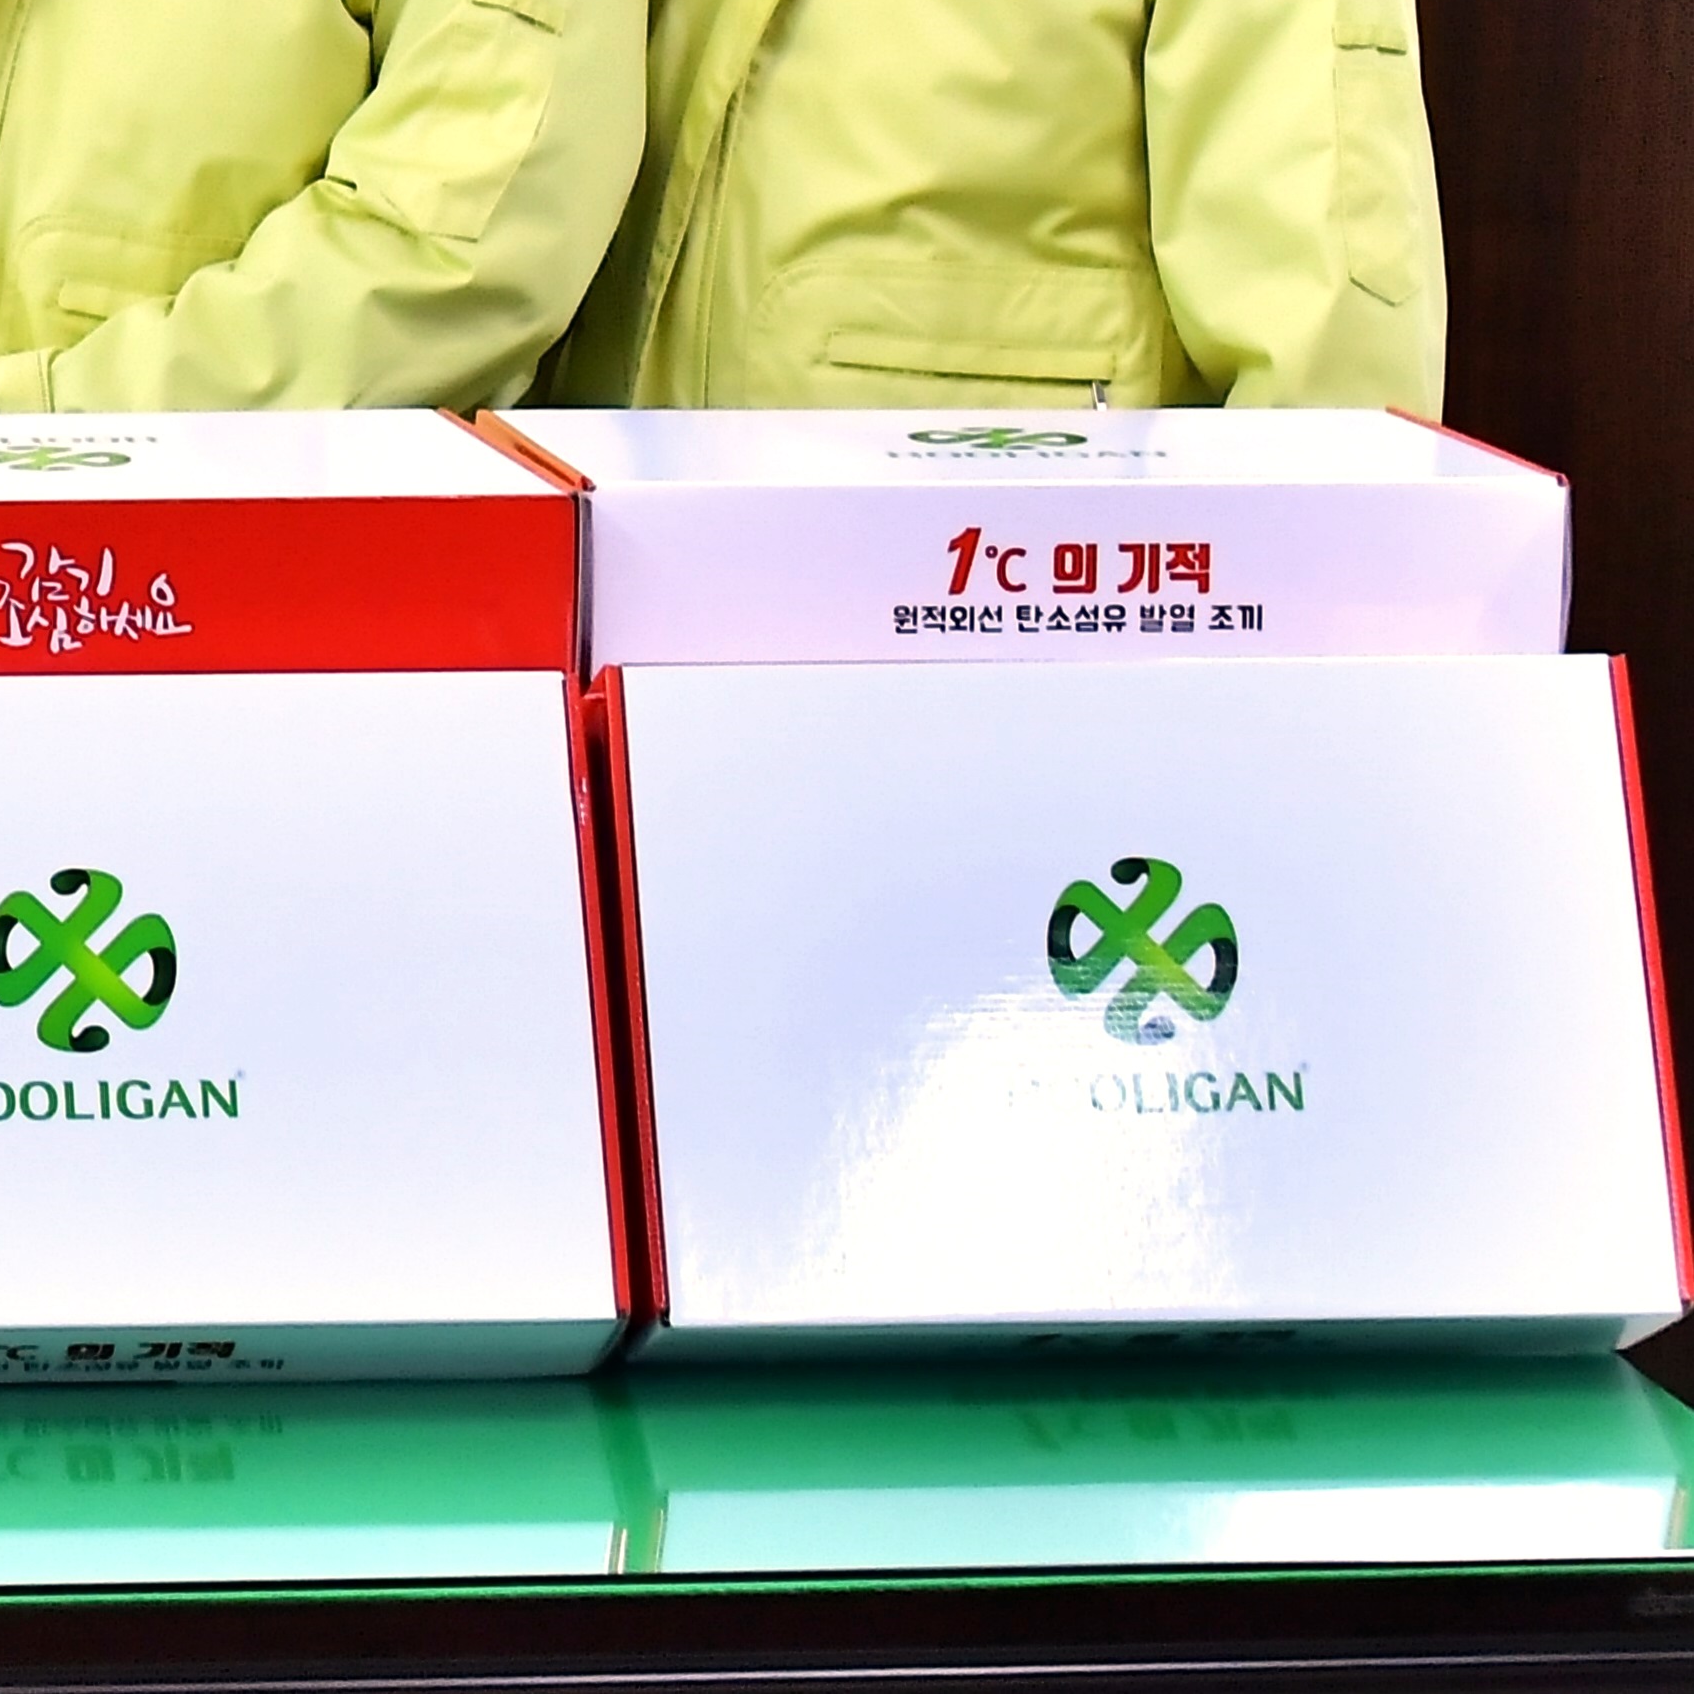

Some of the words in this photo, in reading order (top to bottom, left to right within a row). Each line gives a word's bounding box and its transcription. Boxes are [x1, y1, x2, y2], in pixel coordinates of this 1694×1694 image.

[1053, 543, 1098, 594] 의
[1117, 543, 1211, 594] 기적
[893, 604, 1003, 634] 원적외선
[1015, 604, 1128, 634] 탄소섬유
[1139, 604, 1195, 633] 발열
[1208, 604, 1264, 632] 조끼
